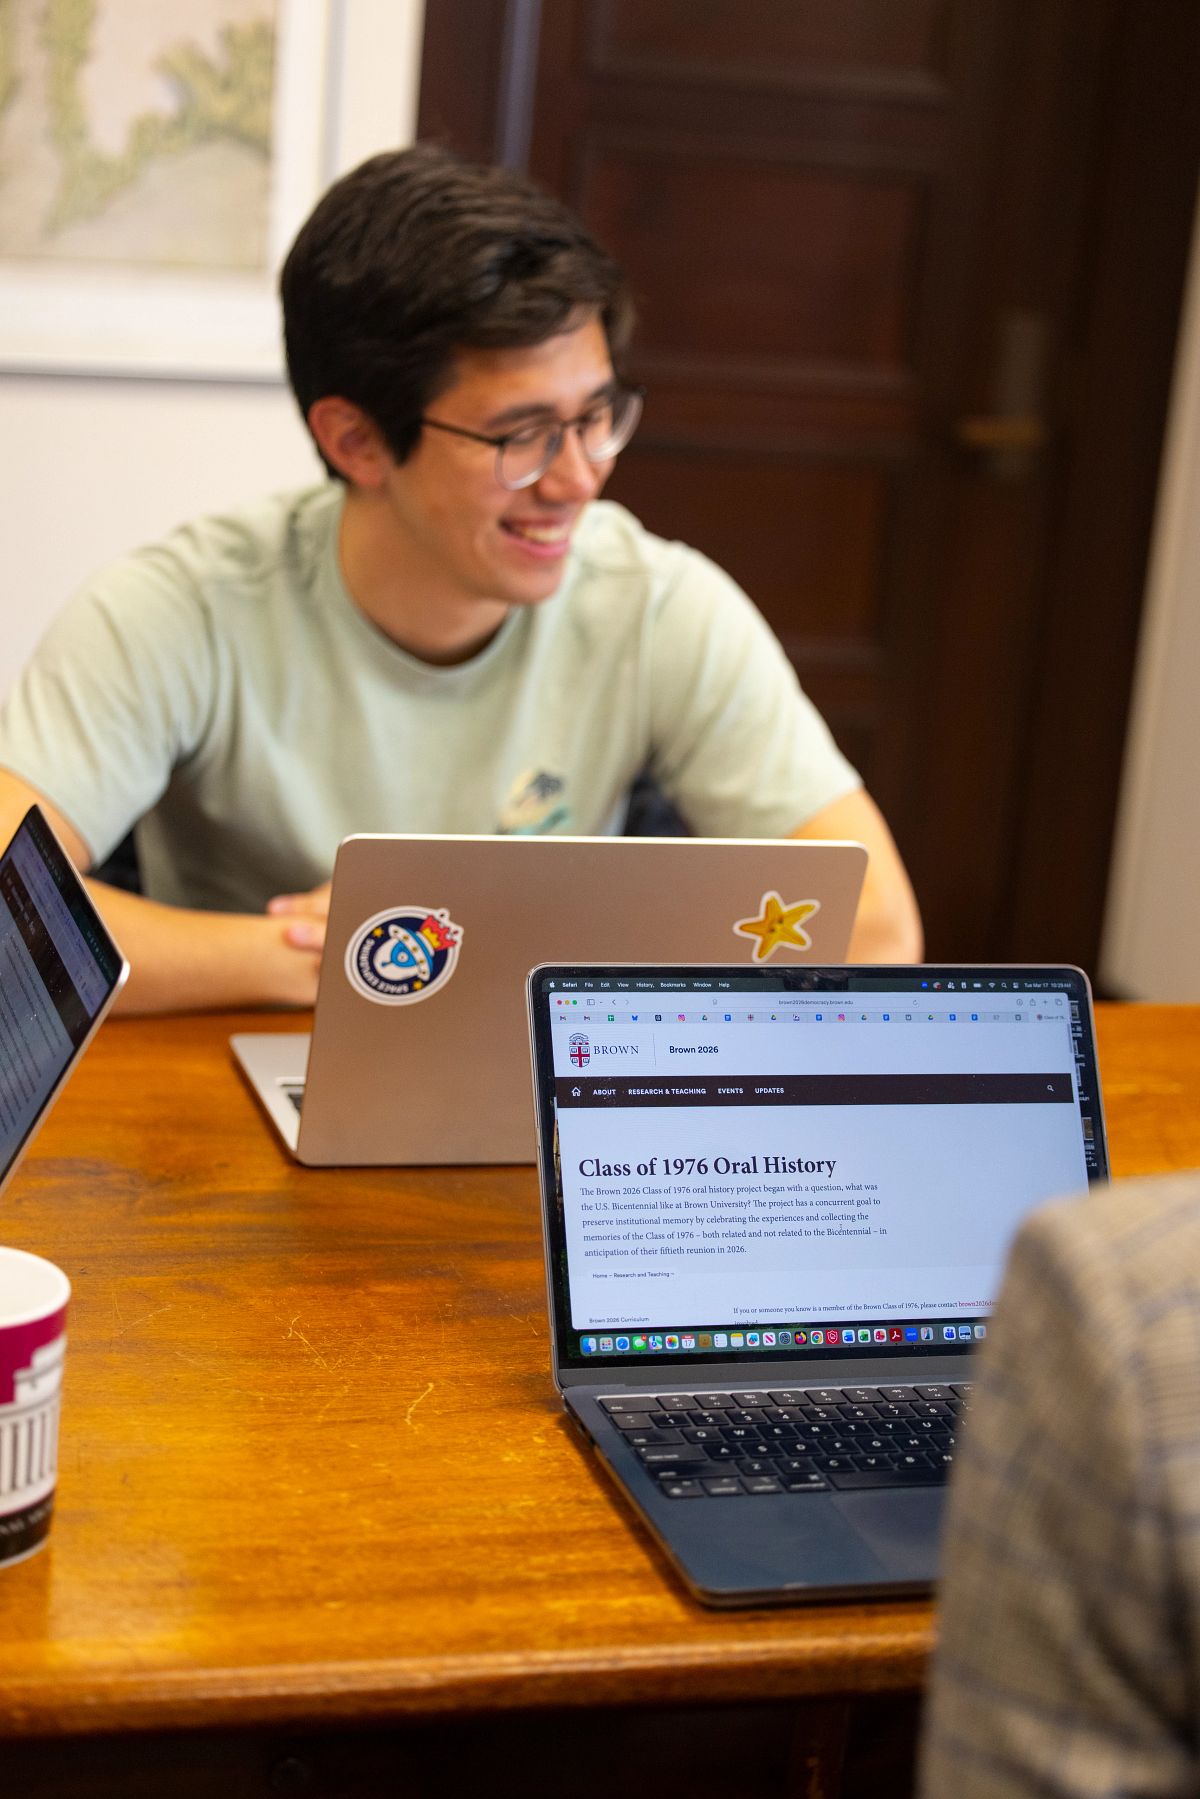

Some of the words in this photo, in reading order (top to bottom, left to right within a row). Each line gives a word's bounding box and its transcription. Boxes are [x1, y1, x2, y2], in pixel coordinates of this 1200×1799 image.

[378, 982, 409, 994] SPACE
[593, 1045, 640, 1055] BROWN
[669, 1046, 696, 1054] Brown
[698, 1046, 719, 1054] 2026
[592, 1088, 617, 1096] ABOUT
[578, 1158, 631, 1177] Class
[636, 1157, 658, 1176] of
[663, 1157, 709, 1176] 1976
[713, 1155, 759, 1175] Oral
[763, 1156, 837, 1179] History
[580, 1187, 595, 1196] The
[596, 1187, 621, 1195] Brown
[622, 1187, 641, 1195] 2026
[642, 1187, 662, 1195] Class
[663, 1186, 672, 1194] of
[673, 1186, 691, 1194] 1976
[692, 1186, 708, 1194] oral
[708, 1185, 735, 1195] history
[736, 1185, 762, 1195] project
[763, 1184, 785, 1195] began
[786, 1184, 803, 1192] with
[810, 1183, 844, 1193] question,
[845, 1183, 863, 1191] what
[581, 1202, 594, 1211] the
[595, 1202, 610, 1211] U.S.
[612, 1201, 658, 1210] Bicentennial
[659, 1201, 673, 1209] like
[684, 1201, 708, 1209] Brown
[710, 1200, 751, 1210] University?
[752, 1199, 768, 1208] The
[768, 1199, 794, 1209] project
[795, 1198, 808, 1207] has
[815, 1198, 855, 1206] concurrent
[856, 1197, 872, 1208] goal
[582, 1218, 614, 1228] preserve
[615, 1216, 661, 1226] institutional
[662, 1217, 694, 1226] memory
[695, 1215, 705, 1226] by
[706, 1215, 747, 1226] celebrating
[748, 1214, 760, 1223] the
[761, 1214, 805, 1224] experiences
[805, 1213, 820, 1222] and
[820, 1212, 856, 1223] collecting
[857, 1212, 869, 1221] the
[583, 1233, 621, 1241] memories
[622, 1232, 631, 1241] of
[631, 1232, 644, 1240] the
[645, 1232, 665, 1240] Class
[666, 1231, 675, 1239] of
[676, 1231, 694, 1239] 1976
[702, 1230, 720, 1239] both
[721, 1229, 747, 1238] related
[748, 1229, 762, 1238] and
[764, 1229, 776, 1237] not
[777, 1228, 803, 1237] related
[813, 1228, 825, 1236] the
[826, 1227, 872, 1236] Bicentennial
[879, 1227, 888, 1235] in
[584, 1248, 629, 1258] anticipation
[630, 1247, 639, 1255] of
[640, 1247, 658, 1255] their
[659, 1246, 685, 1255] fiftieth
[686, 1246, 716, 1254] reunion
[727, 1245, 747, 1253] 2026.
[784, 1307, 795, 1315] you
[920, 1302, 937, 1310] please
